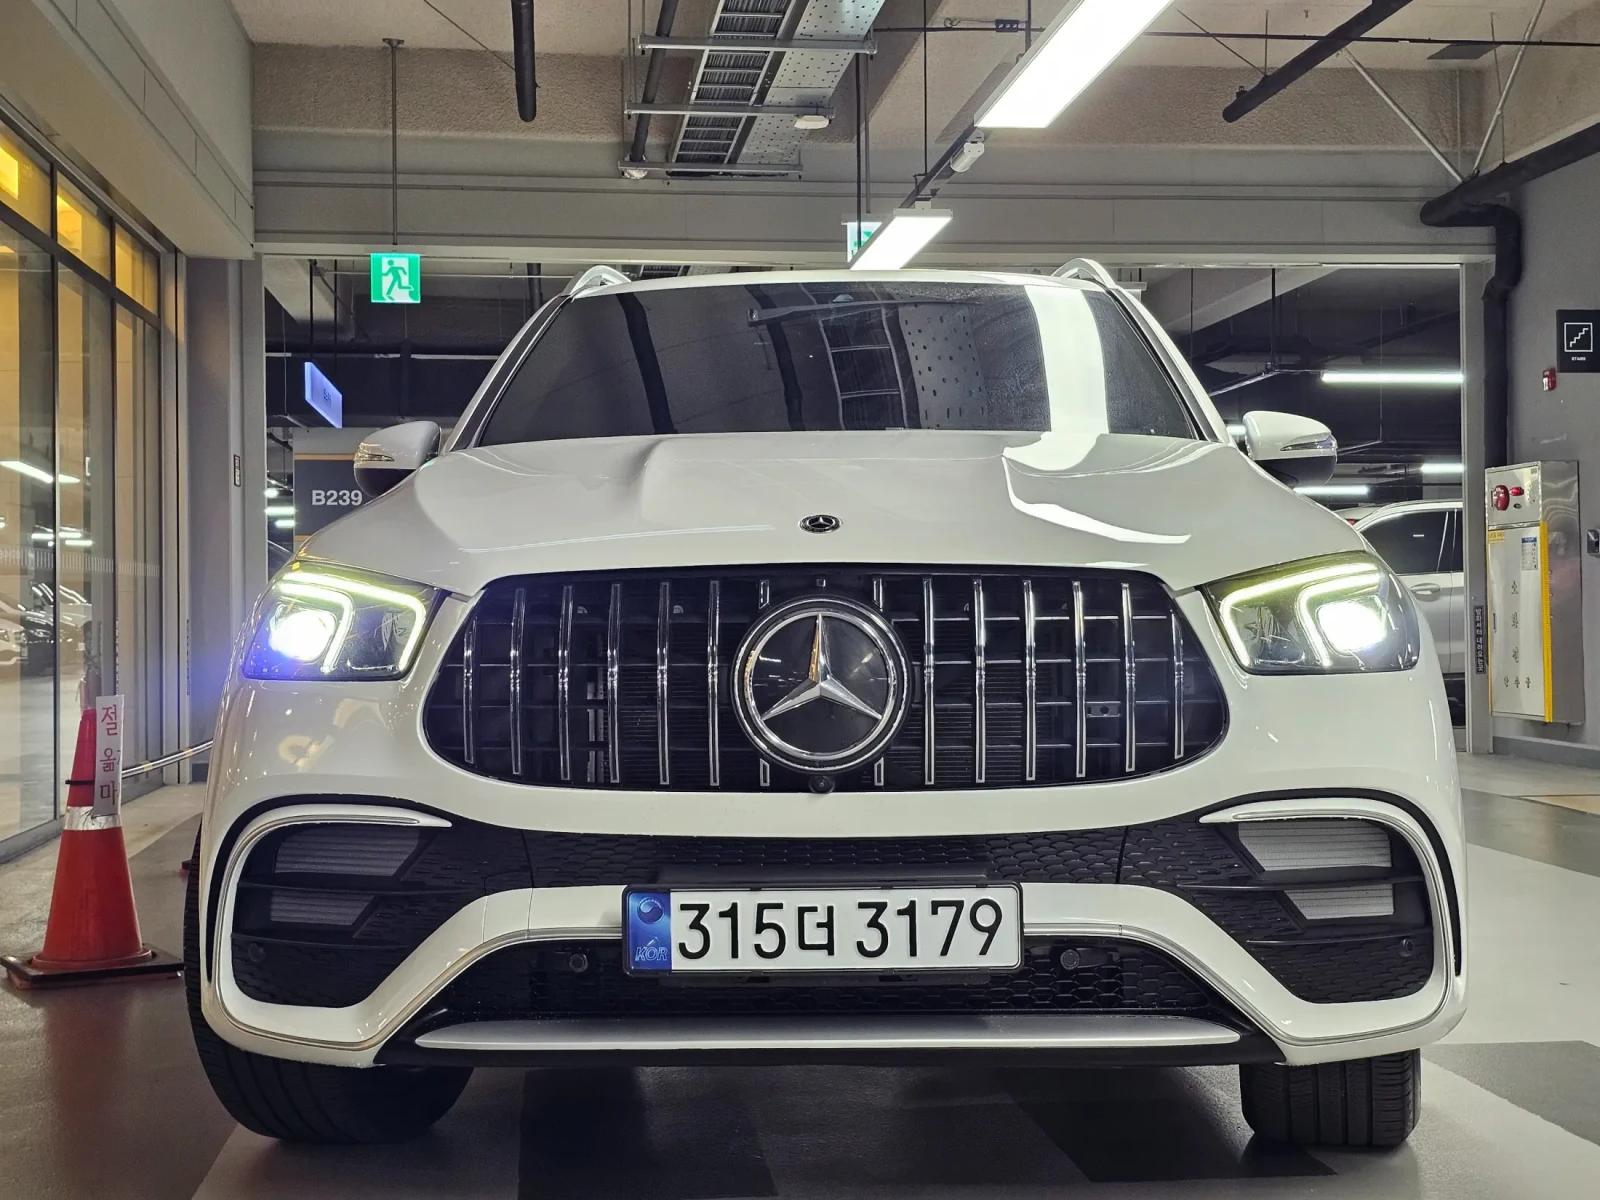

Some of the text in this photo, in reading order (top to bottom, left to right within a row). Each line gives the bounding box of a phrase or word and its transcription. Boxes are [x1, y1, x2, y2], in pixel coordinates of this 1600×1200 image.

[312, 490, 362, 505] B239
[678, 898, 1002, 959] 315더 3179
[635, 946, 668, 961] KOR
